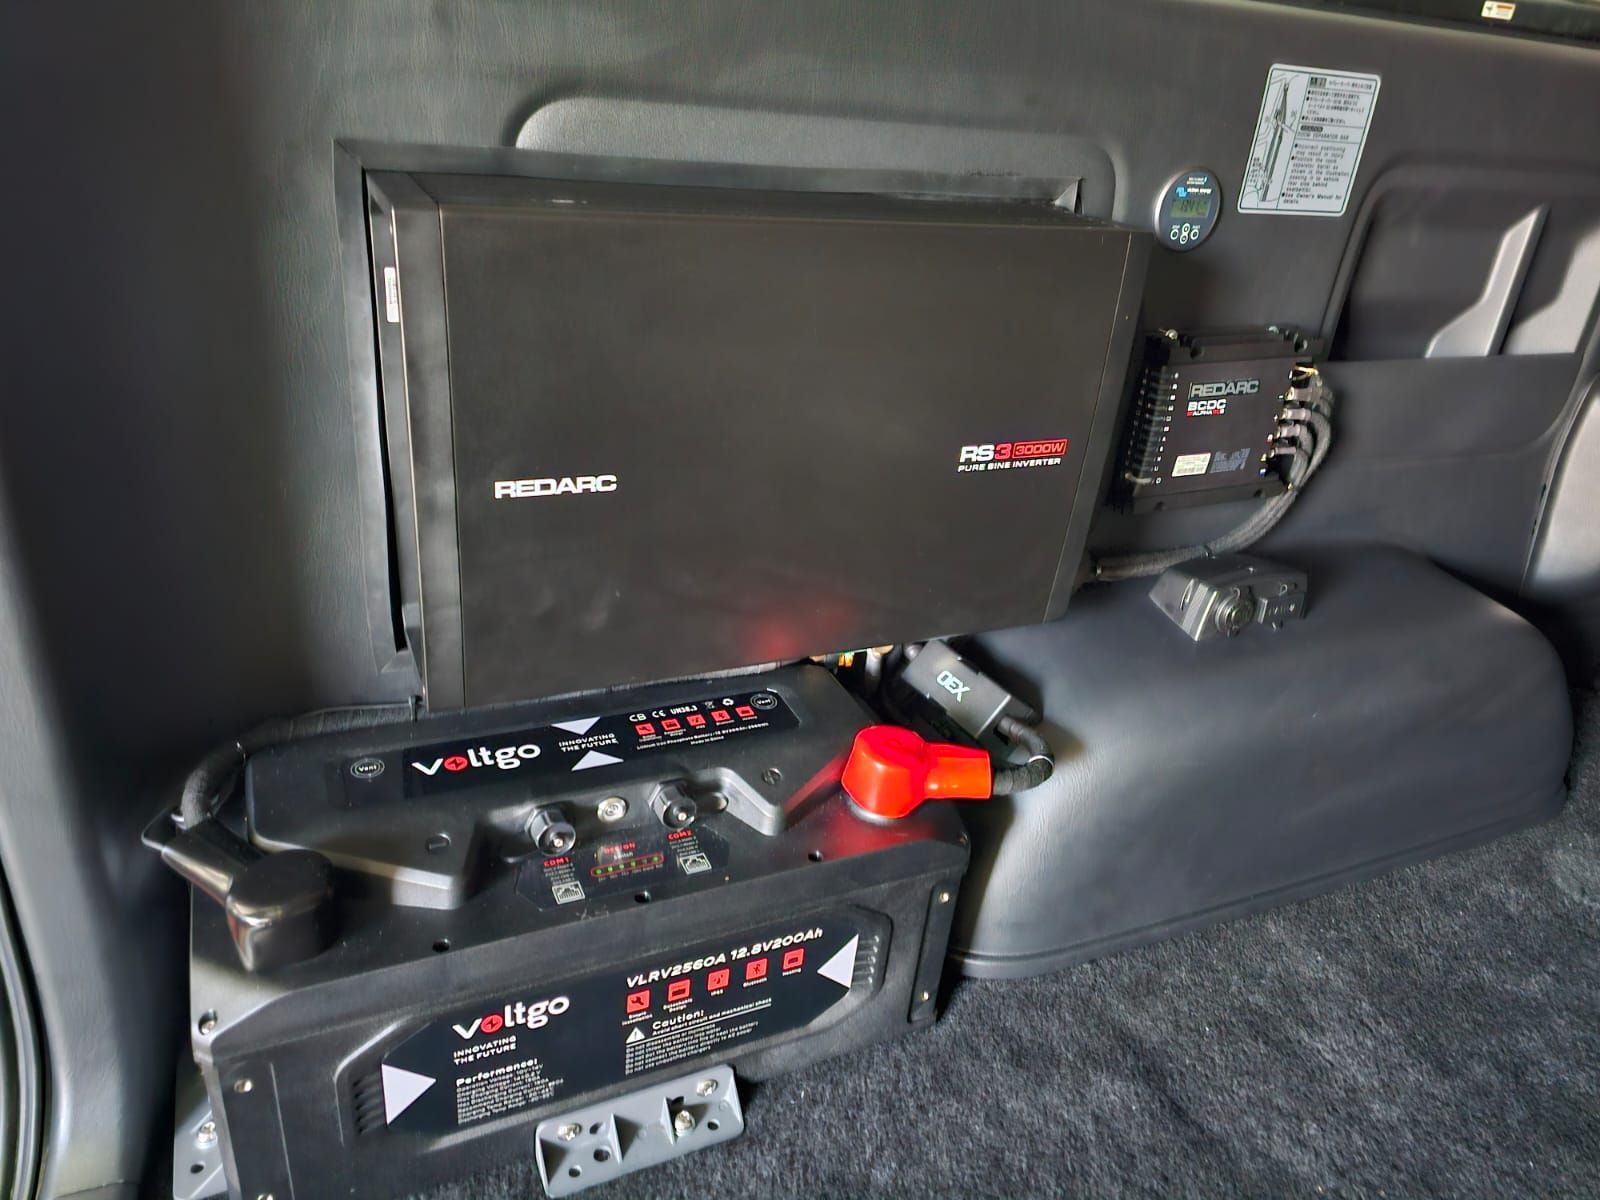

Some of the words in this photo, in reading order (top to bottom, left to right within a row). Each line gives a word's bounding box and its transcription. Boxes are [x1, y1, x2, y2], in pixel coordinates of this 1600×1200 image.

[1190, 380, 1260, 398] REDARC
[1188, 398, 1226, 412] BCDC
[960, 443, 1012, 462] RS3
[1014, 442, 1064, 456] 3000W
[957, 464, 986, 473] PURE
[986, 461, 1011, 470] SINE
[1012, 458, 1062, 468] INVERTER
[494, 474, 618, 499] REDARC
[936, 670, 971, 703] OEX
[629, 713, 647, 722] CB
[558, 732, 615, 748] INNOVATING
[561, 744, 582, 752] THE
[582, 738, 618, 750] FUTURE
[626, 953, 727, 988] VLRV2560A
[730, 927, 824, 961] 12.8V200Ah
[452, 996, 570, 1040] voltgo
[652, 1026, 670, 1036] Avoid
[708, 1012, 721, 1020] and
[453, 1035, 517, 1058] INNOVATING
[454, 1054, 475, 1066] THE
[476, 1042, 517, 1060] FUTURE
